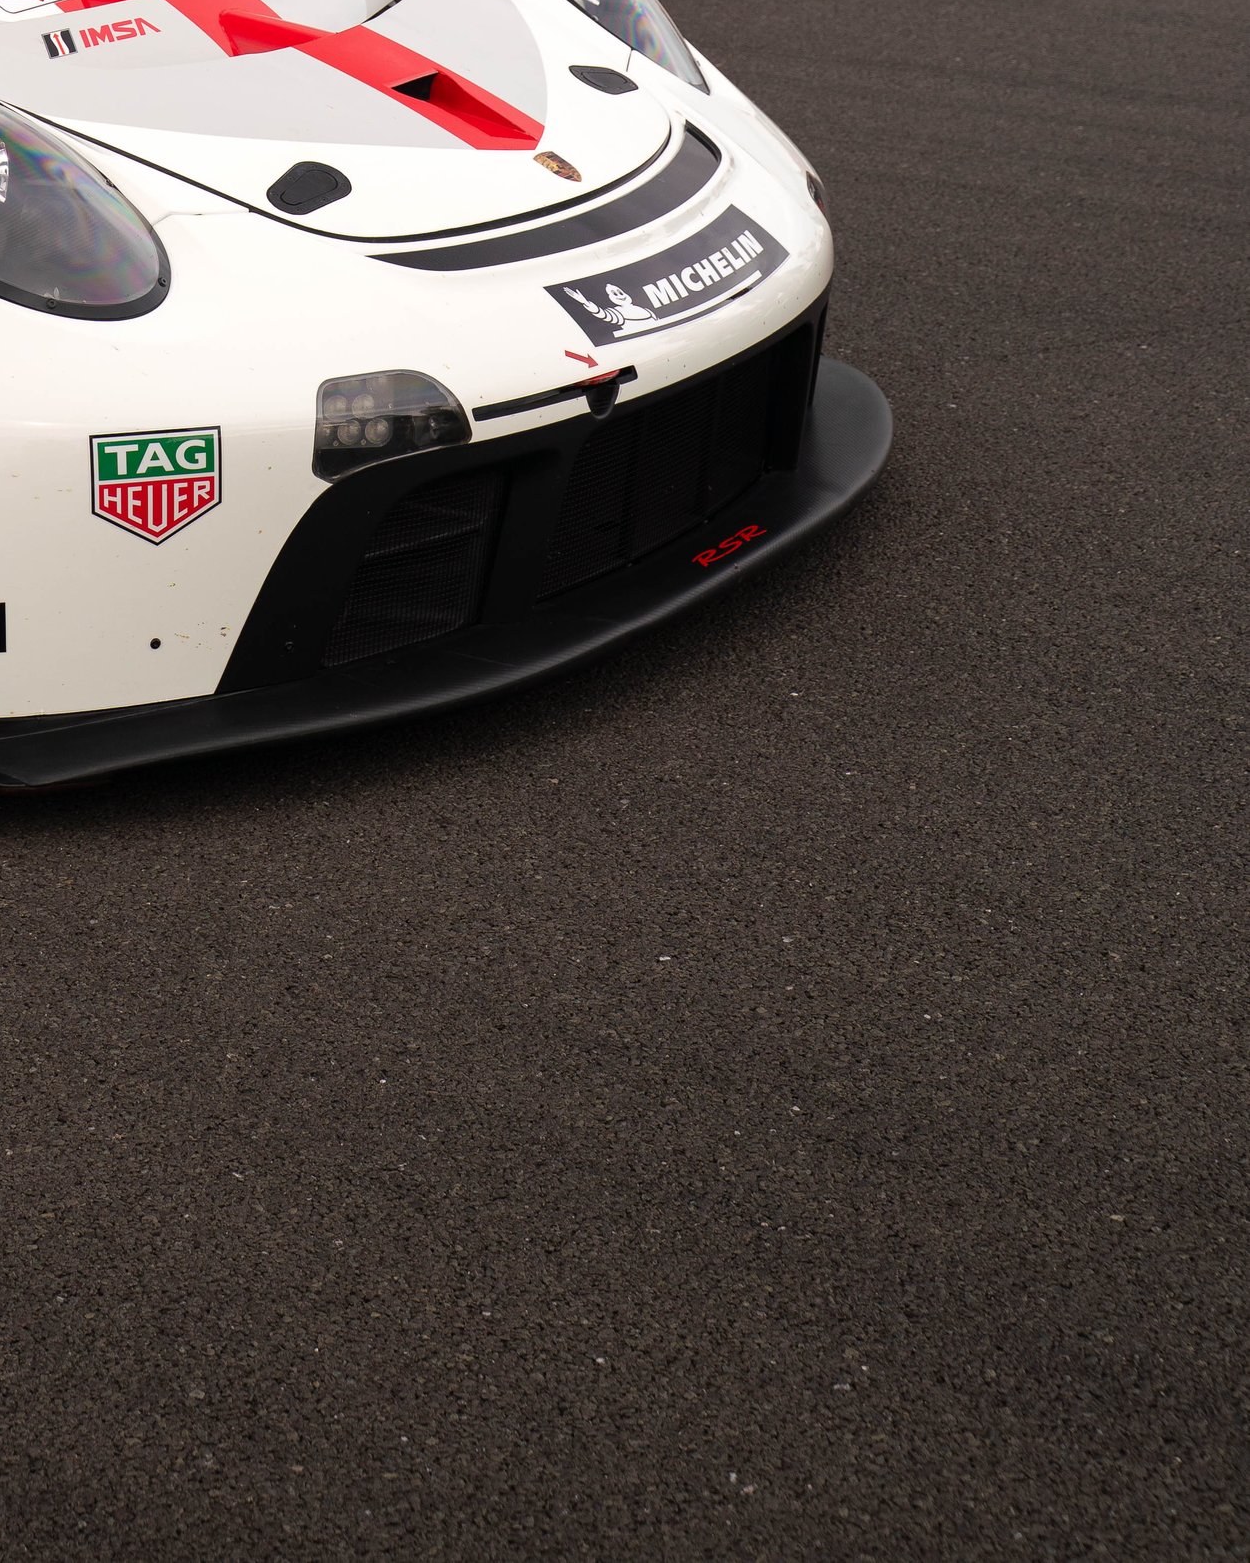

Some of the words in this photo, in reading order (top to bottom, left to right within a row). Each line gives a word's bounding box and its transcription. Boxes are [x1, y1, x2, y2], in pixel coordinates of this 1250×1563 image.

[79, 17, 161, 49] IMSA
[642, 229, 764, 309] MICHELIN
[104, 439, 207, 475] TAG
[103, 480, 211, 533] HEUER
[691, 524, 767, 567] RSR
